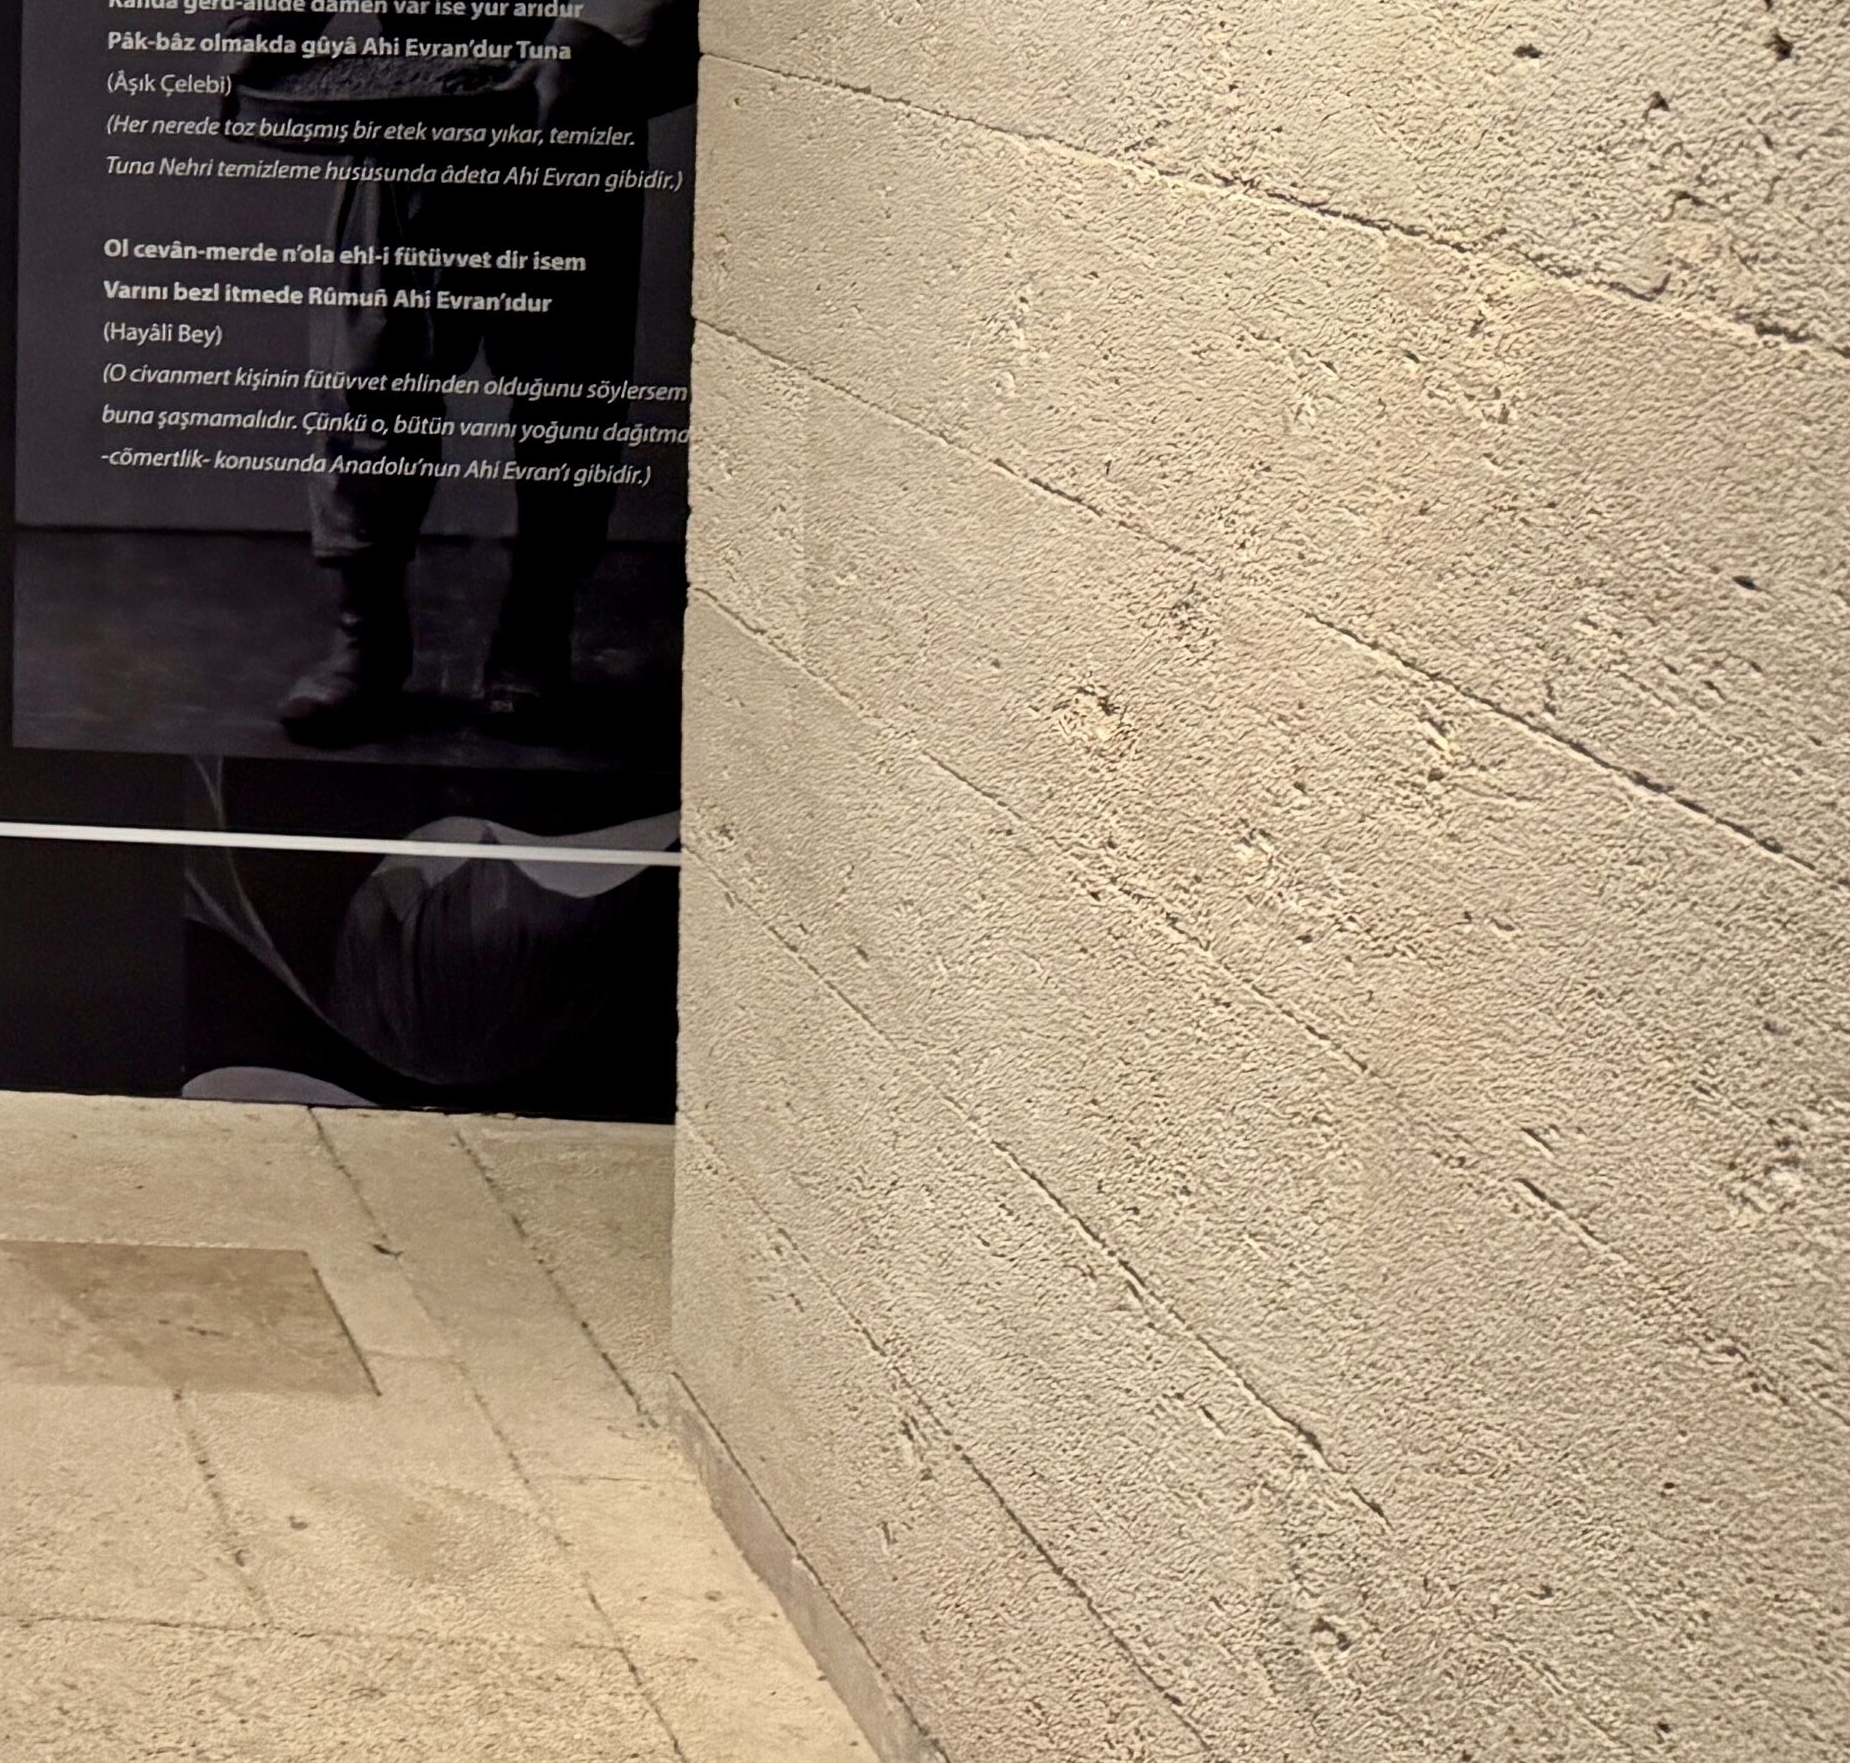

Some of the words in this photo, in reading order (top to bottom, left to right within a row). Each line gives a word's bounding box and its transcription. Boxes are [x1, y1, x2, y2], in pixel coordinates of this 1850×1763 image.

[394, 0, 430, 14] var
[471, 2, 509, 20] yur
[514, 0, 584, 18] arıdur
[109, 32, 195, 51] Pâk-bâz
[200, 34, 296, 54] olmakda
[302, 36, 356, 58] gûyâ
[362, 37, 399, 56] Ahi
[516, 41, 572, 60] Tuna
[107, 70, 155, 96] (Âşık
[161, 74, 232, 96] Çelebi)
[107, 115, 148, 134] (Her
[153, 116, 219, 136] nerede
[224, 121, 255, 137] toz
[259, 118, 348, 143] bulaşmış
[353, 120, 382, 139] bir
[384, 122, 427, 139] etek
[431, 127, 486, 142] varsa
[488, 124, 544, 147] yıkar,
[550, 126, 635, 146] temizler.
[106, 156, 155, 175] Tuna
[159, 157, 213, 177] Nehri
[218, 160, 321, 180] temizleme
[325, 162, 436, 183] hususunda
[441, 165, 500, 184] âdeta
[504, 166, 539, 186] Ahi
[543, 169, 600, 187] Evran
[605, 170, 683, 192] gibidir.)
[104, 239, 128, 258] Ol
[134, 241, 278, 262] cevân-merde
[340, 246, 389, 265] ehl-i
[394, 247, 492, 268] fütüvvet
[496, 250, 528, 269] dir
[533, 251, 586, 271] isem
[104, 280, 168, 300] Varını
[173, 282, 219, 301] bezl
[225, 283, 303, 304] itmede
[309, 286, 388, 307] Rûmuñ
[393, 289, 431, 309] Ahi
[178, 324, 222, 348] Bey)
[103, 362, 126, 383] (O
[130, 364, 229, 386] civanmert
[235, 367, 299, 391] kişinin
[303, 369, 388, 391] fütüvvet
[391, 373, 479, 394] ehlinden
[483, 376, 582, 401] olduğunu
[586, 380, 688, 404] söylersem
[101, 404, 154, 425] buna
[158, 408, 298, 430] şaşmamalıdır.
[302, 411, 367, 435] Çünkü
[371, 417, 389, 435] o,
[394, 414, 455, 435] bütün
[460, 421, 517, 438] varını
[518, 421, 599, 444] yoğunu
[101, 447, 211, 468] -cömertlik-
[214, 450, 326, 473] konusunda
[463, 460, 499, 479] Ahi
[574, 464, 652, 487] gibidir.)
